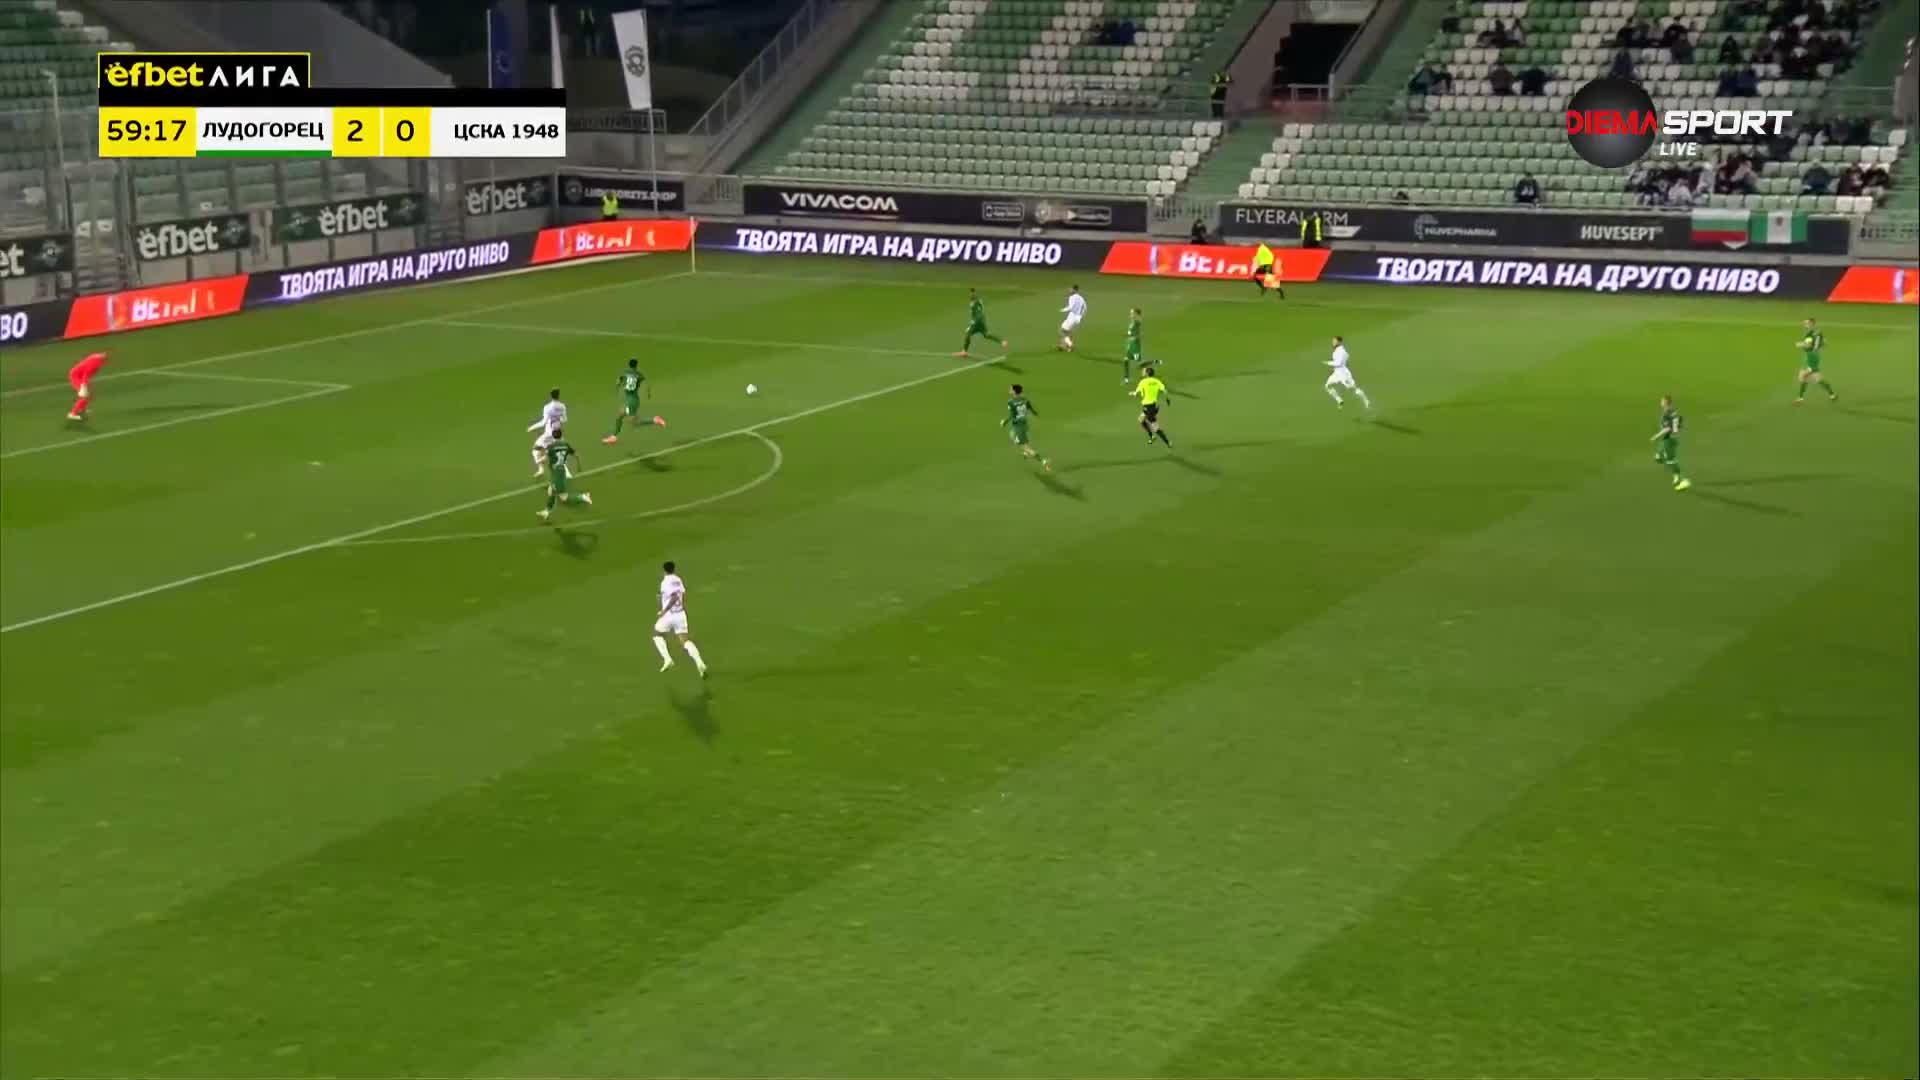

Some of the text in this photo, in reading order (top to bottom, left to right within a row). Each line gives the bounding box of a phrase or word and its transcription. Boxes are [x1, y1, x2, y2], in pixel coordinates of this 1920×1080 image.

[780, 192, 899, 211] VIVACOM
[736, 228, 1062, 265] ТВОЯТА ИГРА НА ДРУГО НИВО
[280, 241, 510, 298] ТВОЯТА ИГРА НА ДРУГО НИВО
[1376, 258, 1780, 293] ТВОЯТА ИГРА НА ДРУГО НИВО
